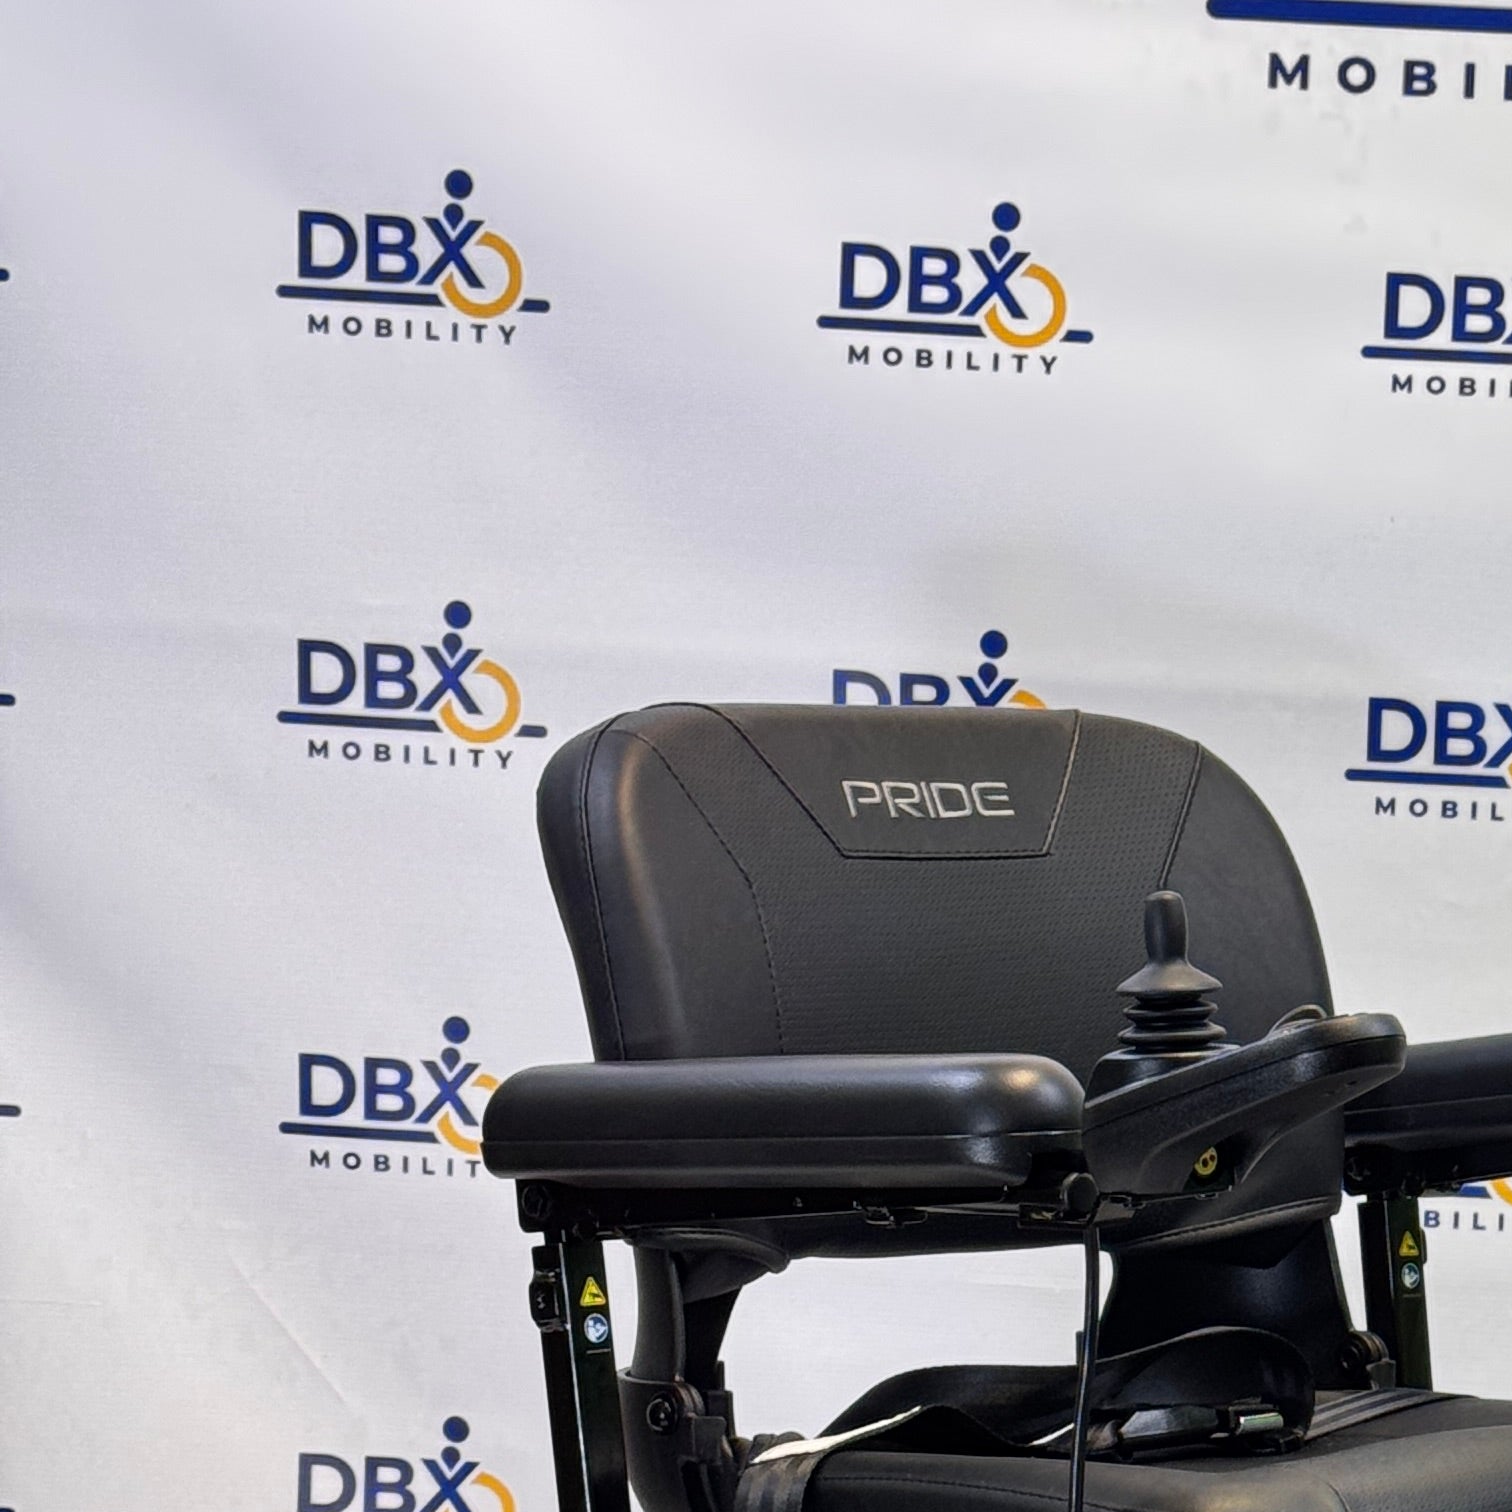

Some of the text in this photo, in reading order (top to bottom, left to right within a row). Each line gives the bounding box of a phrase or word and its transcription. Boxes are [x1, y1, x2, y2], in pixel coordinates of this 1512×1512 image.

[298, 210, 485, 289] DBX
[839, 242, 1030, 320] DBX
[308, 314, 516, 345] MOBILITY
[848, 345, 1056, 374] MOBILITY
[298, 639, 482, 715] DBX
[309, 740, 512, 769] MOBILITY
[841, 780, 1015, 819] PRIDE
[299, 1053, 480, 1126] DBX
[310, 1150, 480, 1177] MOBILIT
